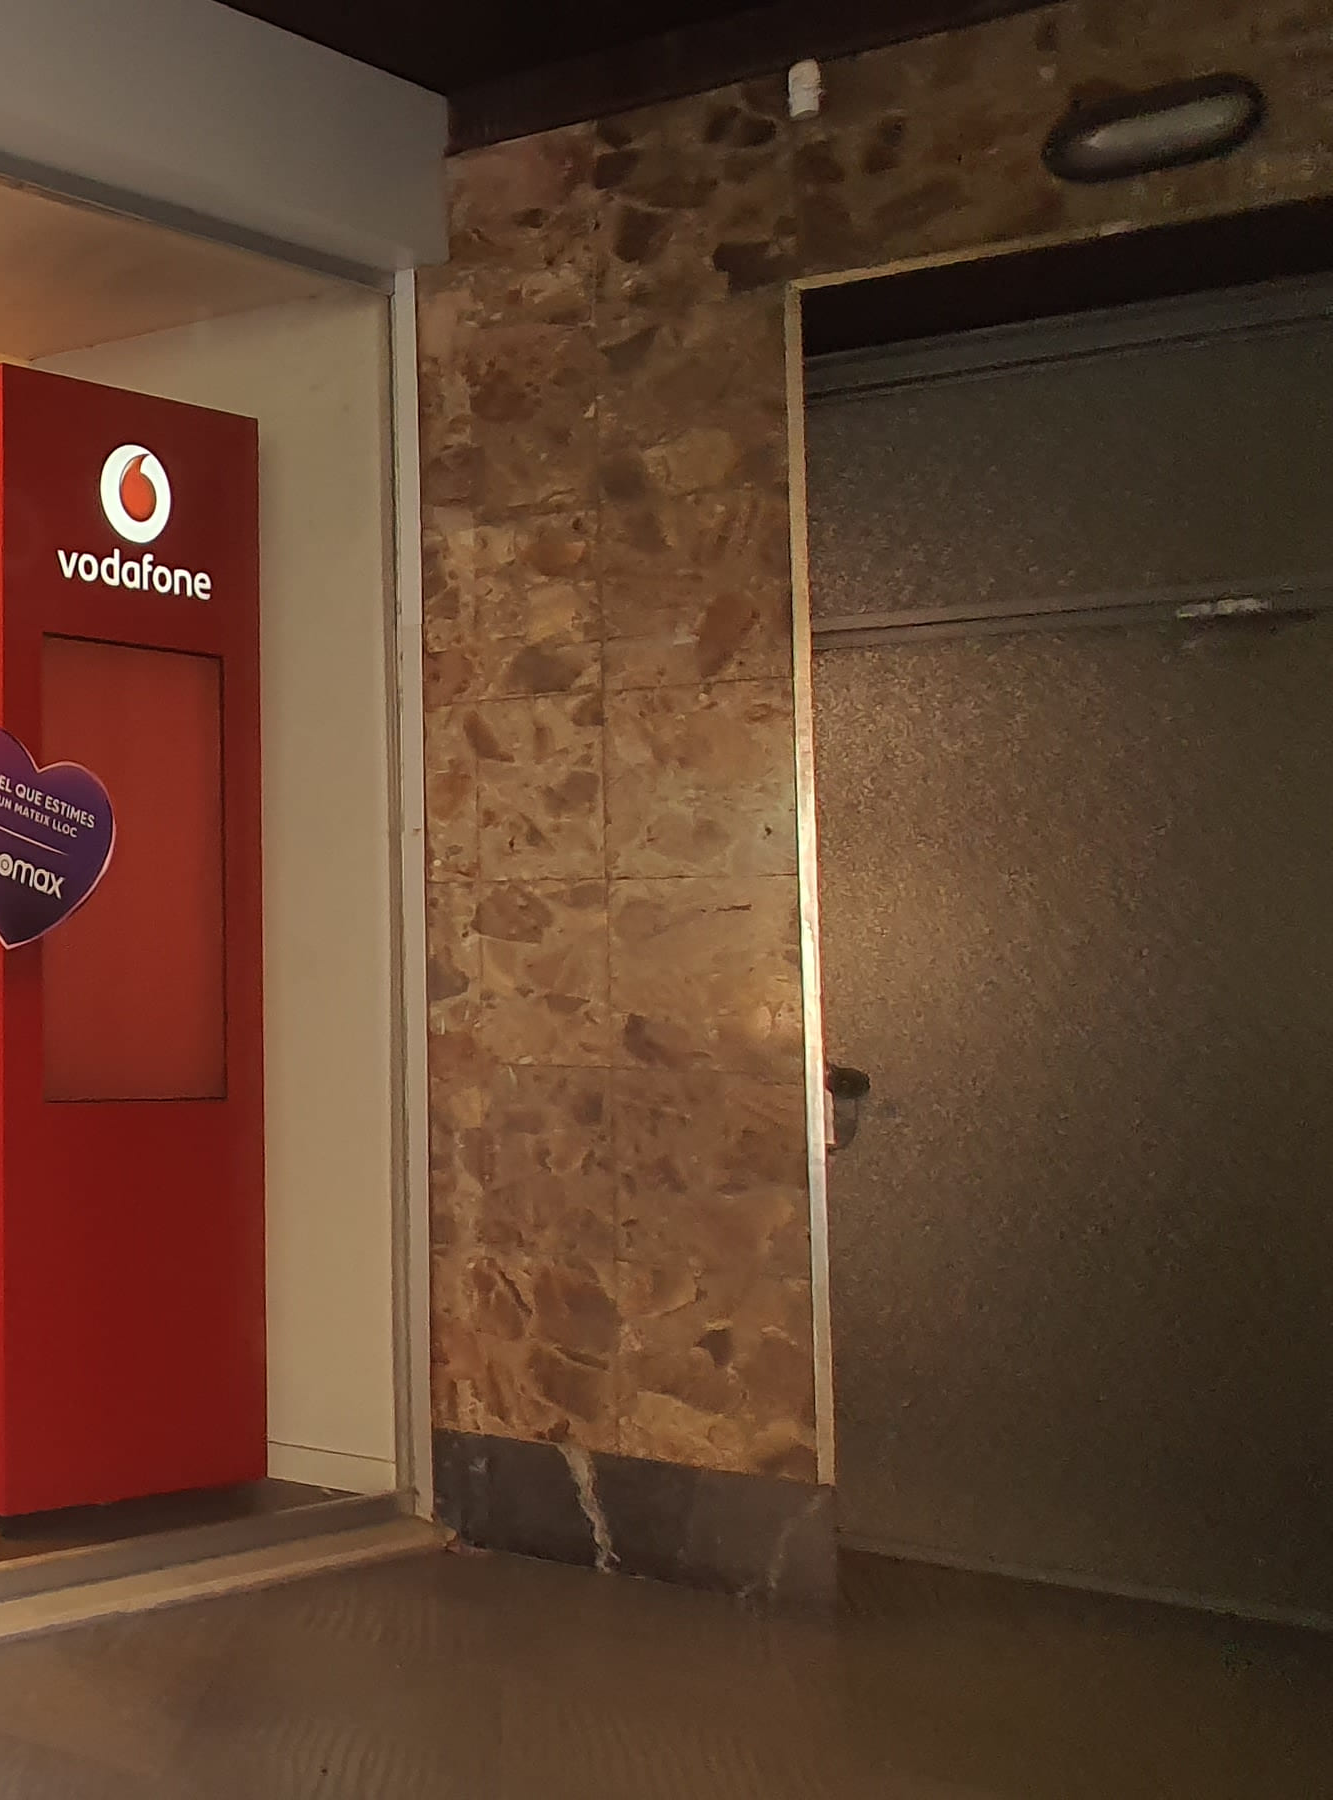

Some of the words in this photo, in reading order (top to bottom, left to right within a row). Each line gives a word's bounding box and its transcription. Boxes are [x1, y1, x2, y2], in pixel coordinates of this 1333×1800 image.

[56, 547, 213, 601] vodafone
[14, 802, 50, 827] MATEIX
[52, 818, 78, 838] LLOC
[15, 783, 43, 806] QUE
[44, 794, 96, 829] ESTIMES
